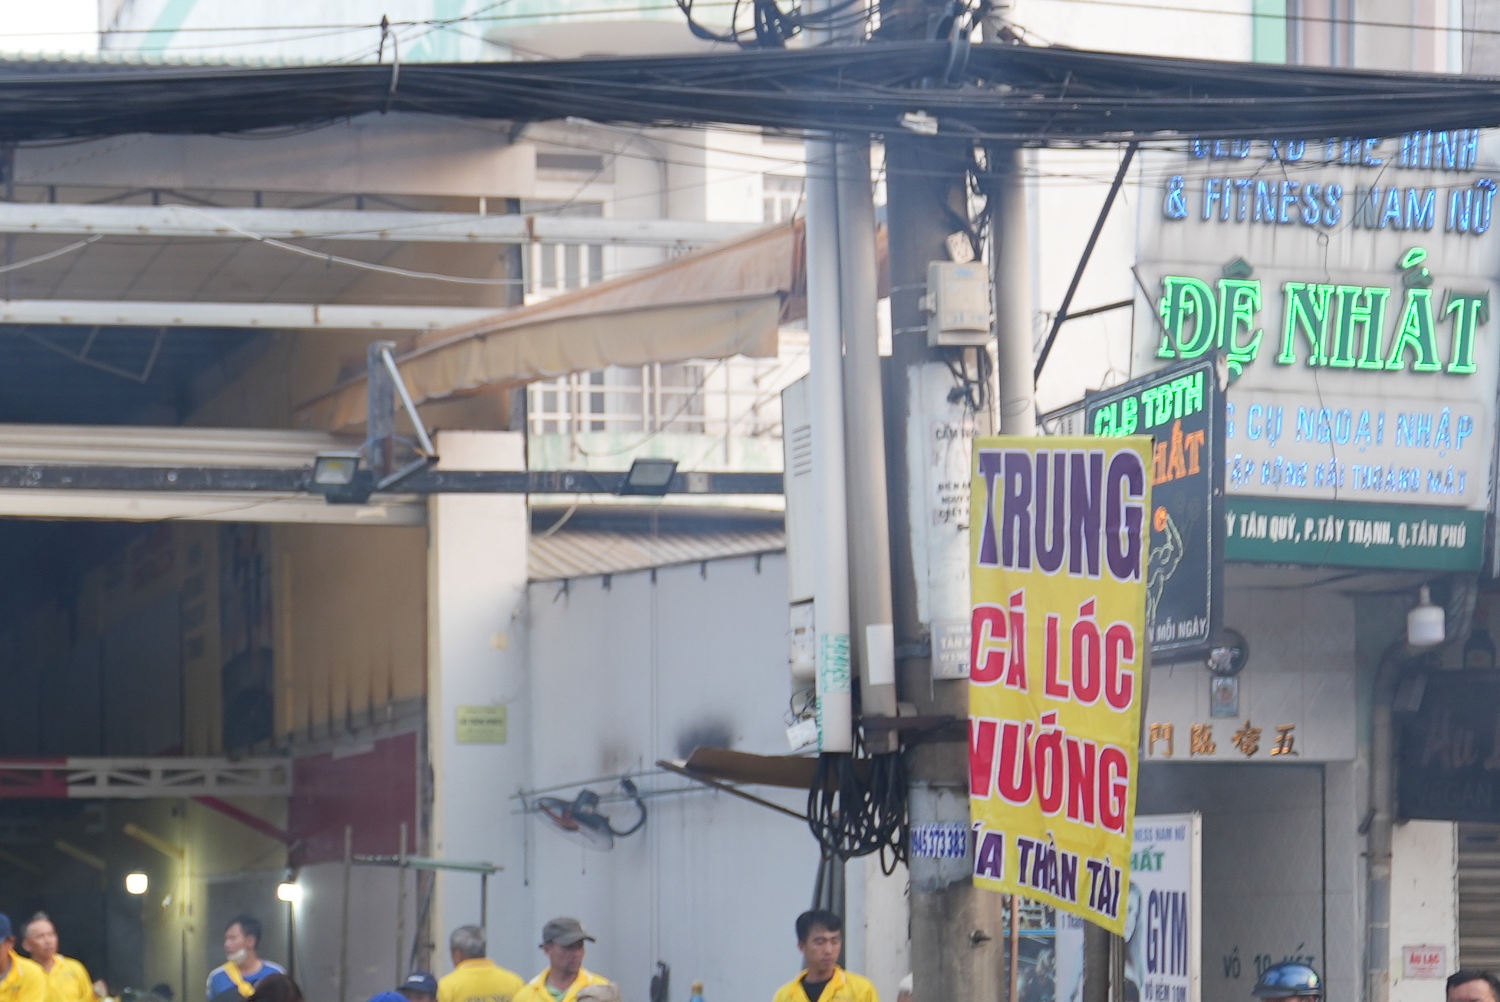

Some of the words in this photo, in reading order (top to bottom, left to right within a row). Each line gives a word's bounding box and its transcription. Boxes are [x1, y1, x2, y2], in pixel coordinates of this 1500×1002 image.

[1202, 178, 1342, 225] FITNESS
[1353, 185, 1434, 230] NAM
[1094, 396, 1138, 437] CLB
[979, 452, 1143, 580] TRUNG
[970, 590, 1028, 692] CÁ
[1045, 599, 1134, 709] LÓC
[1087, 857, 1121, 917] TÀI
[1132, 844, 1165, 871] HẤT
[1146, 889, 1188, 977] GYM
